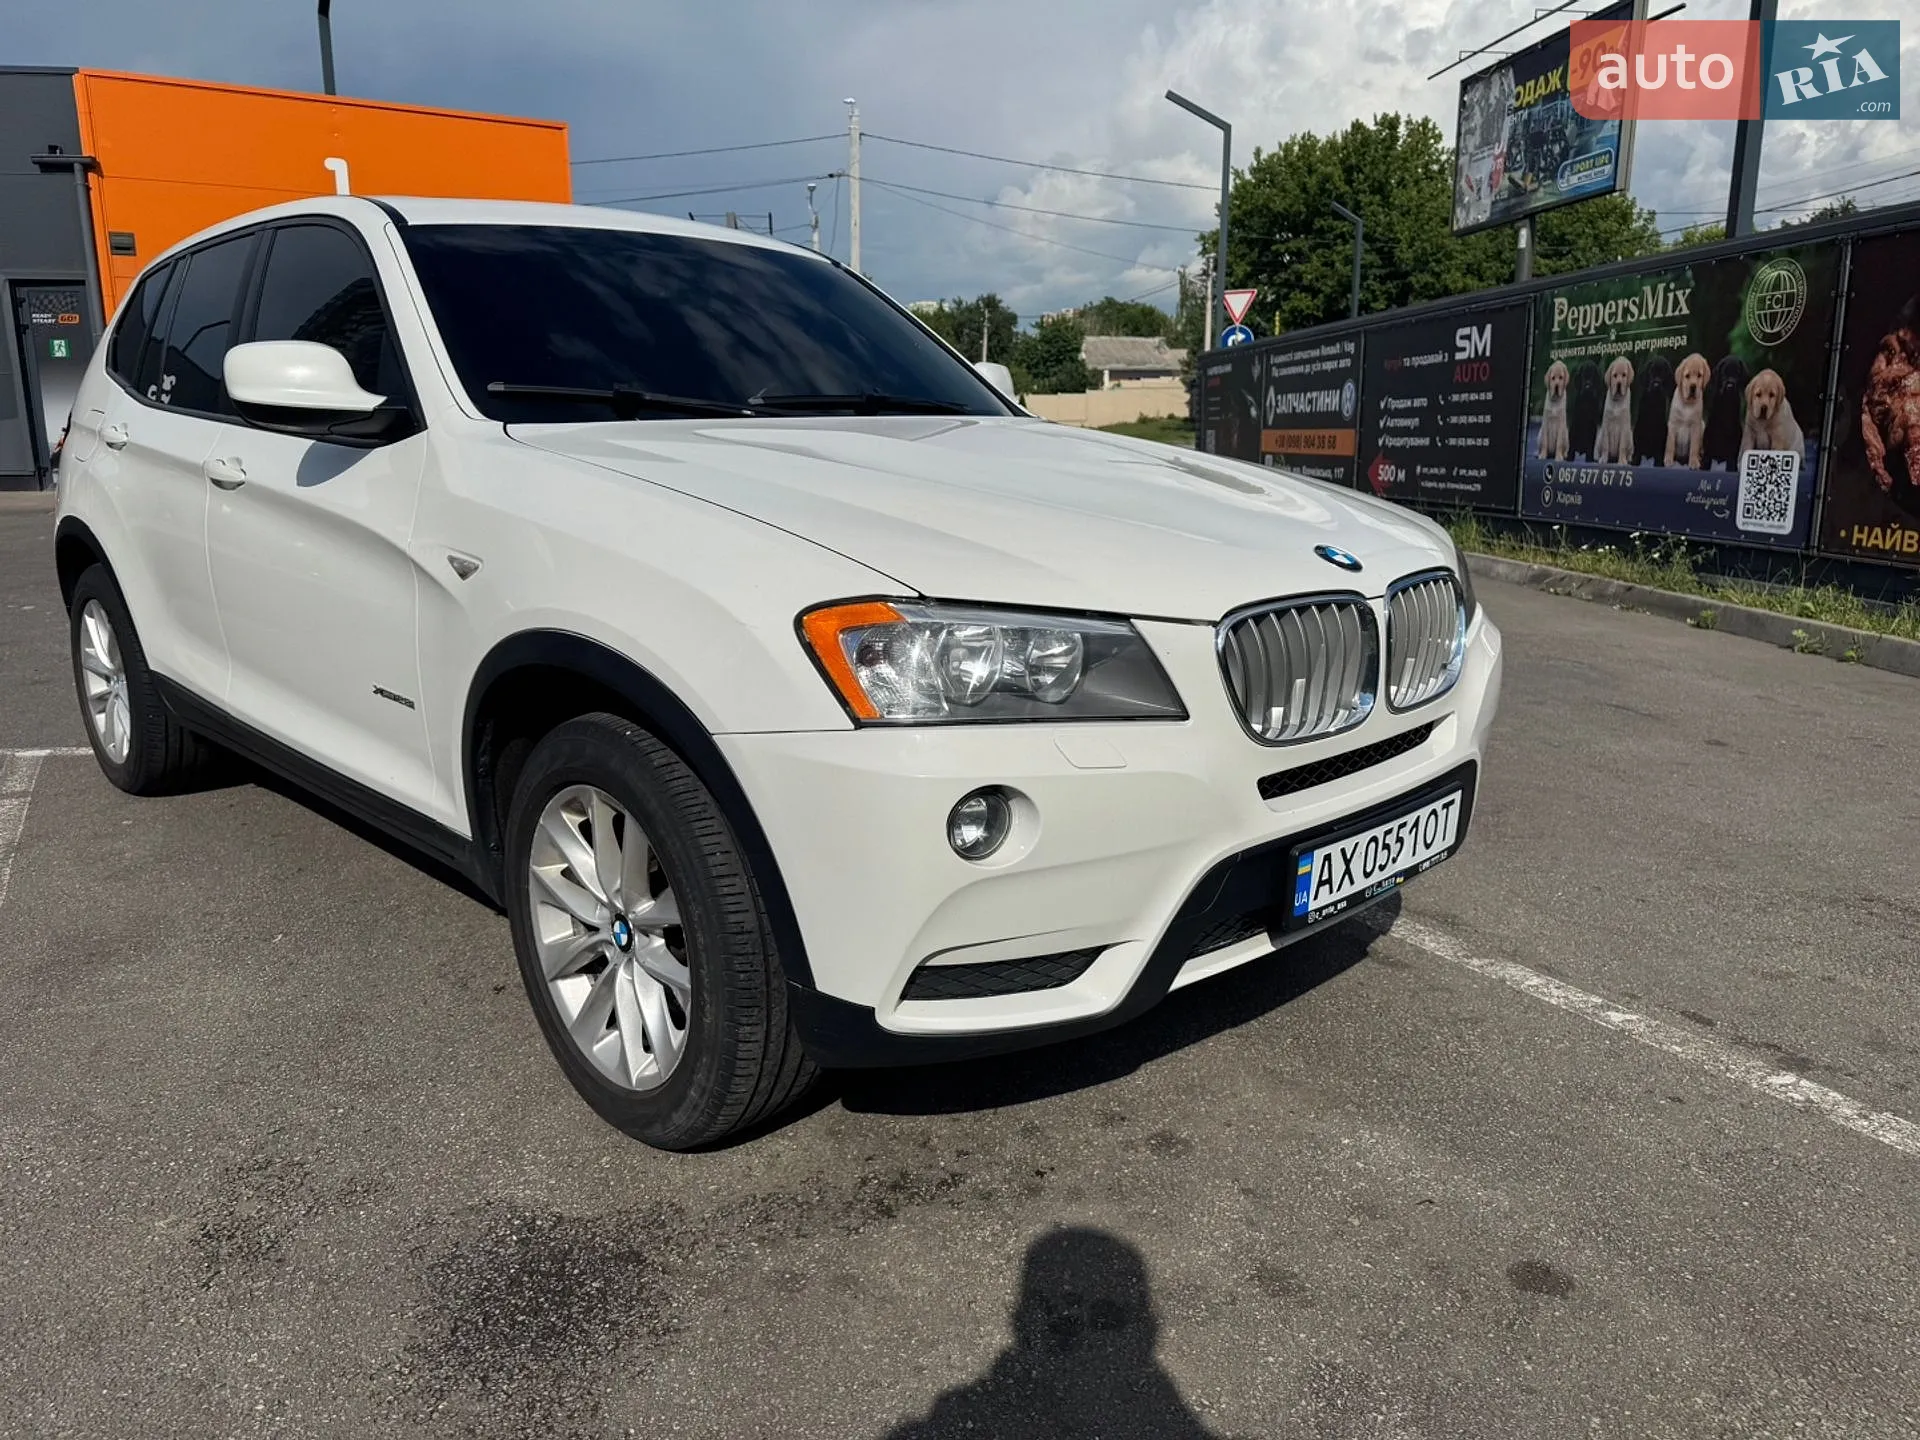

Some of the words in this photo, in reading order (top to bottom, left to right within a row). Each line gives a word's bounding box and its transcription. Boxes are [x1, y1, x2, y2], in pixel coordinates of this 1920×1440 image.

[1552, 282, 1692, 337] PeppersMix
[1766, 294, 1787, 312] FCI
[1455, 323, 1492, 360] SM
[1550, 345, 1585, 361] цуценята
[1587, 340, 1633, 358] лабрадора
[1634, 335, 1688, 354] ретривера
[1454, 362, 1490, 384] AUTO
[1276, 389, 1340, 415] ЗАПЧАСТИНИ
[1387, 397, 1412, 411] Продаж
[1413, 397, 1428, 408] авто
[1387, 415, 1420, 430] Автовикуп
[1378, 464, 1396, 482] 500
[1558, 467, 1577, 483] 067
[1579, 467, 1600, 485] 577
[1602, 469, 1616, 486] 67
[1619, 470, 1633, 487] 75
[1556, 491, 1583, 507] Харків
[1294, 893, 1308, 907] UA
